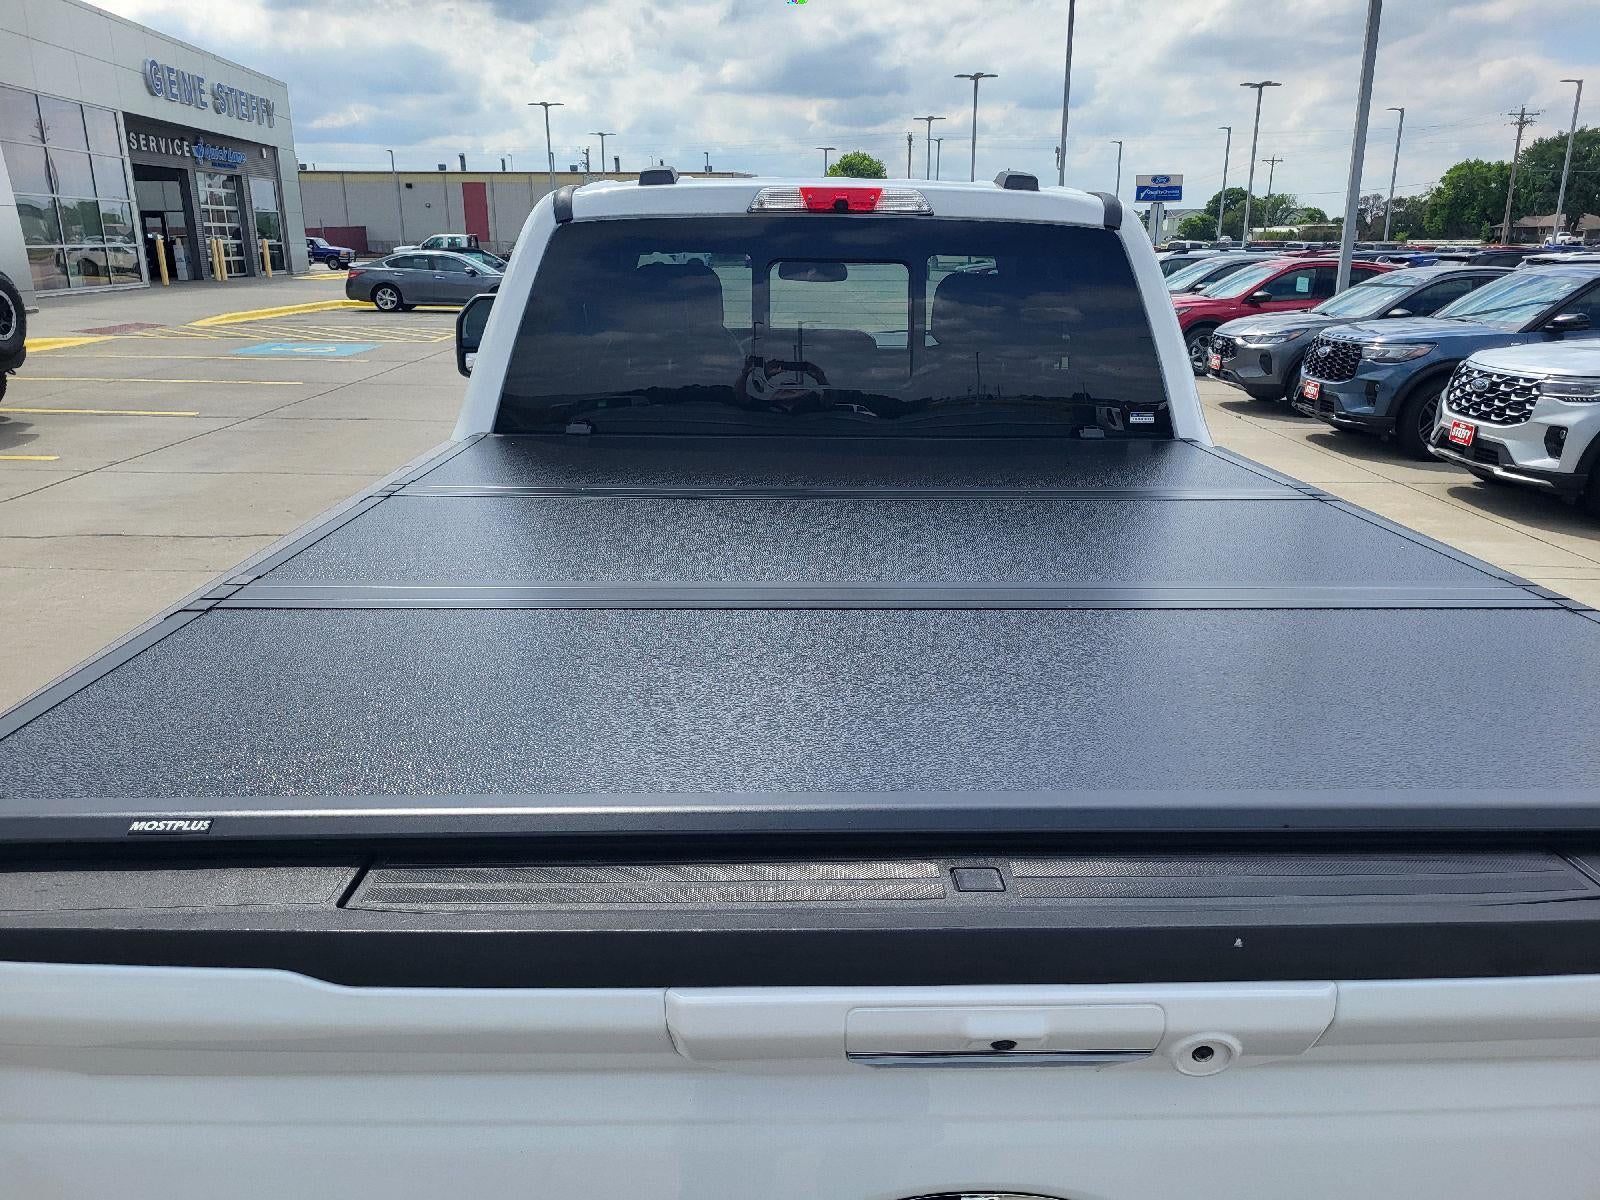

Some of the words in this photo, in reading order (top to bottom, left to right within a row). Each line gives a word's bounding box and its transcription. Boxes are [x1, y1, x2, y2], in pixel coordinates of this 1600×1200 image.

[145, 57, 208, 110] GENE
[213, 82, 275, 128] STEFFY
[129, 132, 190, 157] SERVICE
[129, 820, 211, 831] MOSTPLUS
